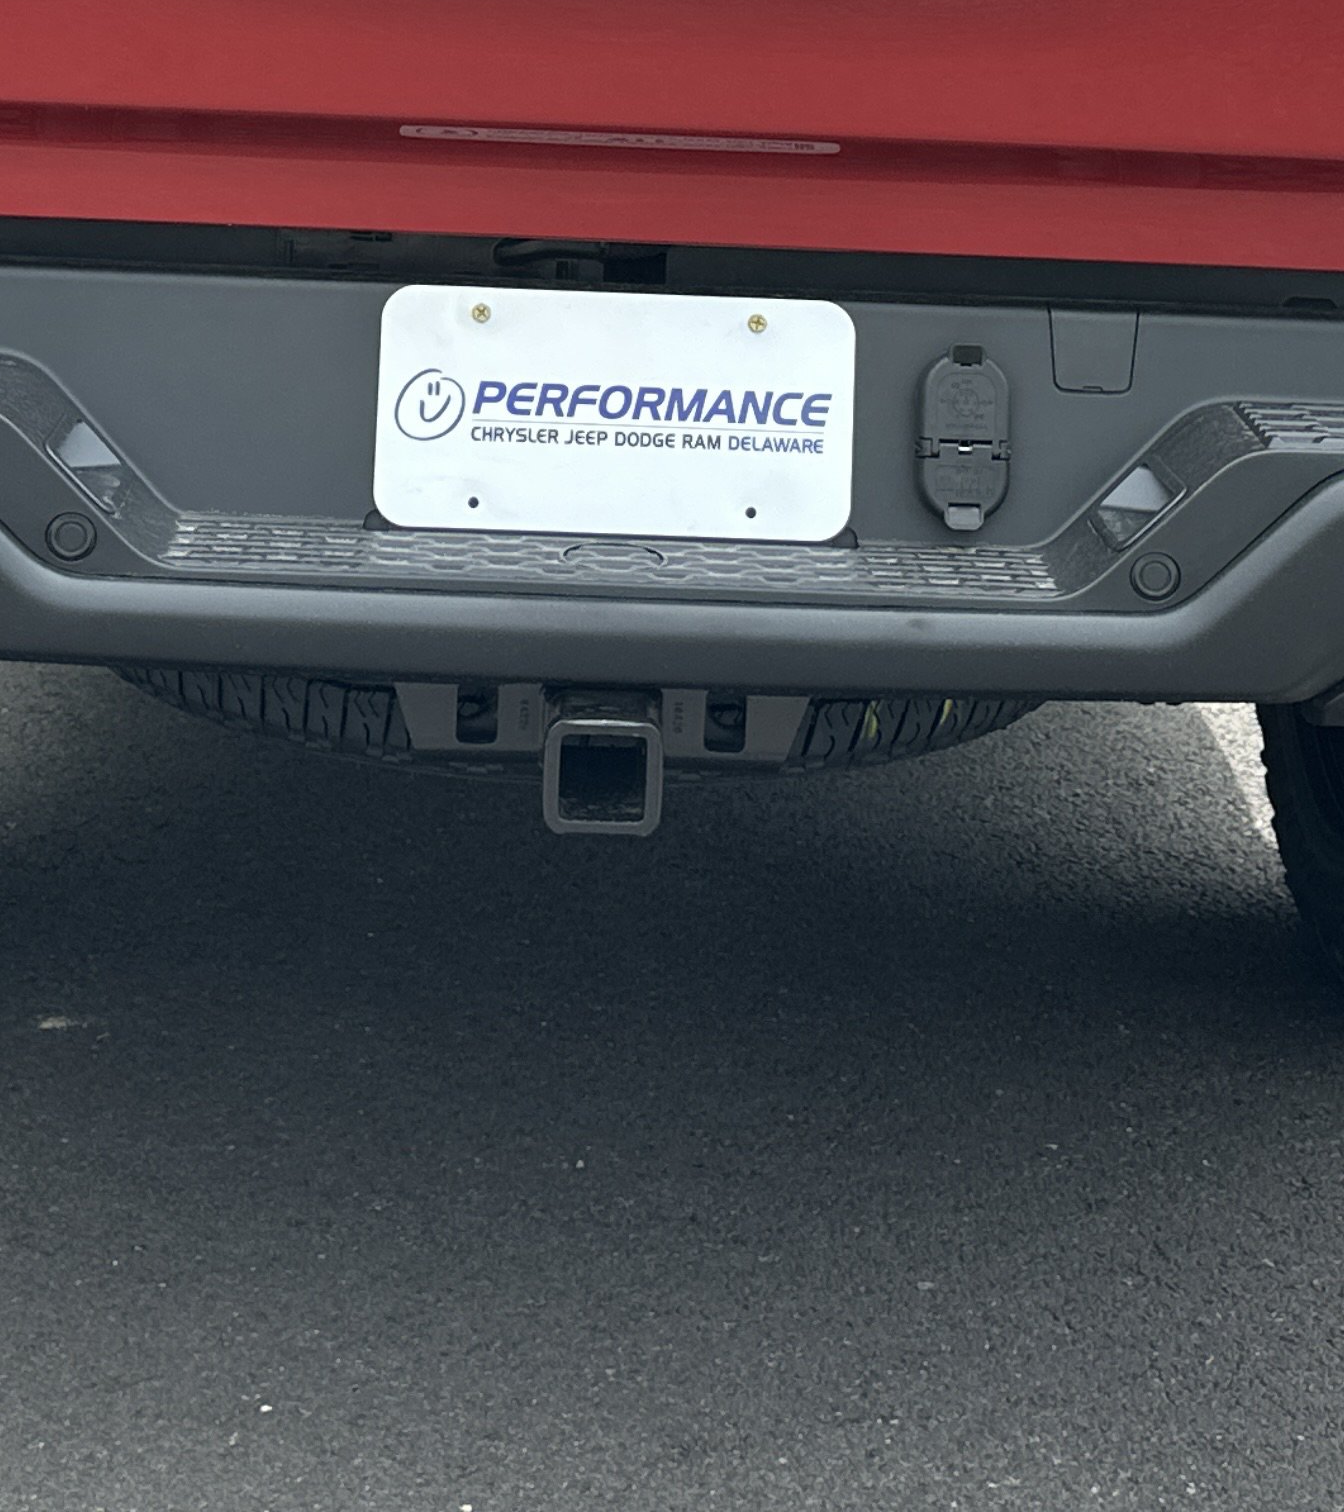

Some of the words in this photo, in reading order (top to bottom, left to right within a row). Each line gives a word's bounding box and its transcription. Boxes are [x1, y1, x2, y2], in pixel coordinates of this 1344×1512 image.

[472, 380, 833, 428] PERFORMANCE
[470, 425, 559, 444] CHRYSLER
[564, 429, 608, 446] JEEP
[614, 431, 676, 449] DODGE
[681, 433, 722, 451] RAM
[728, 435, 824, 455] DELAWARE
